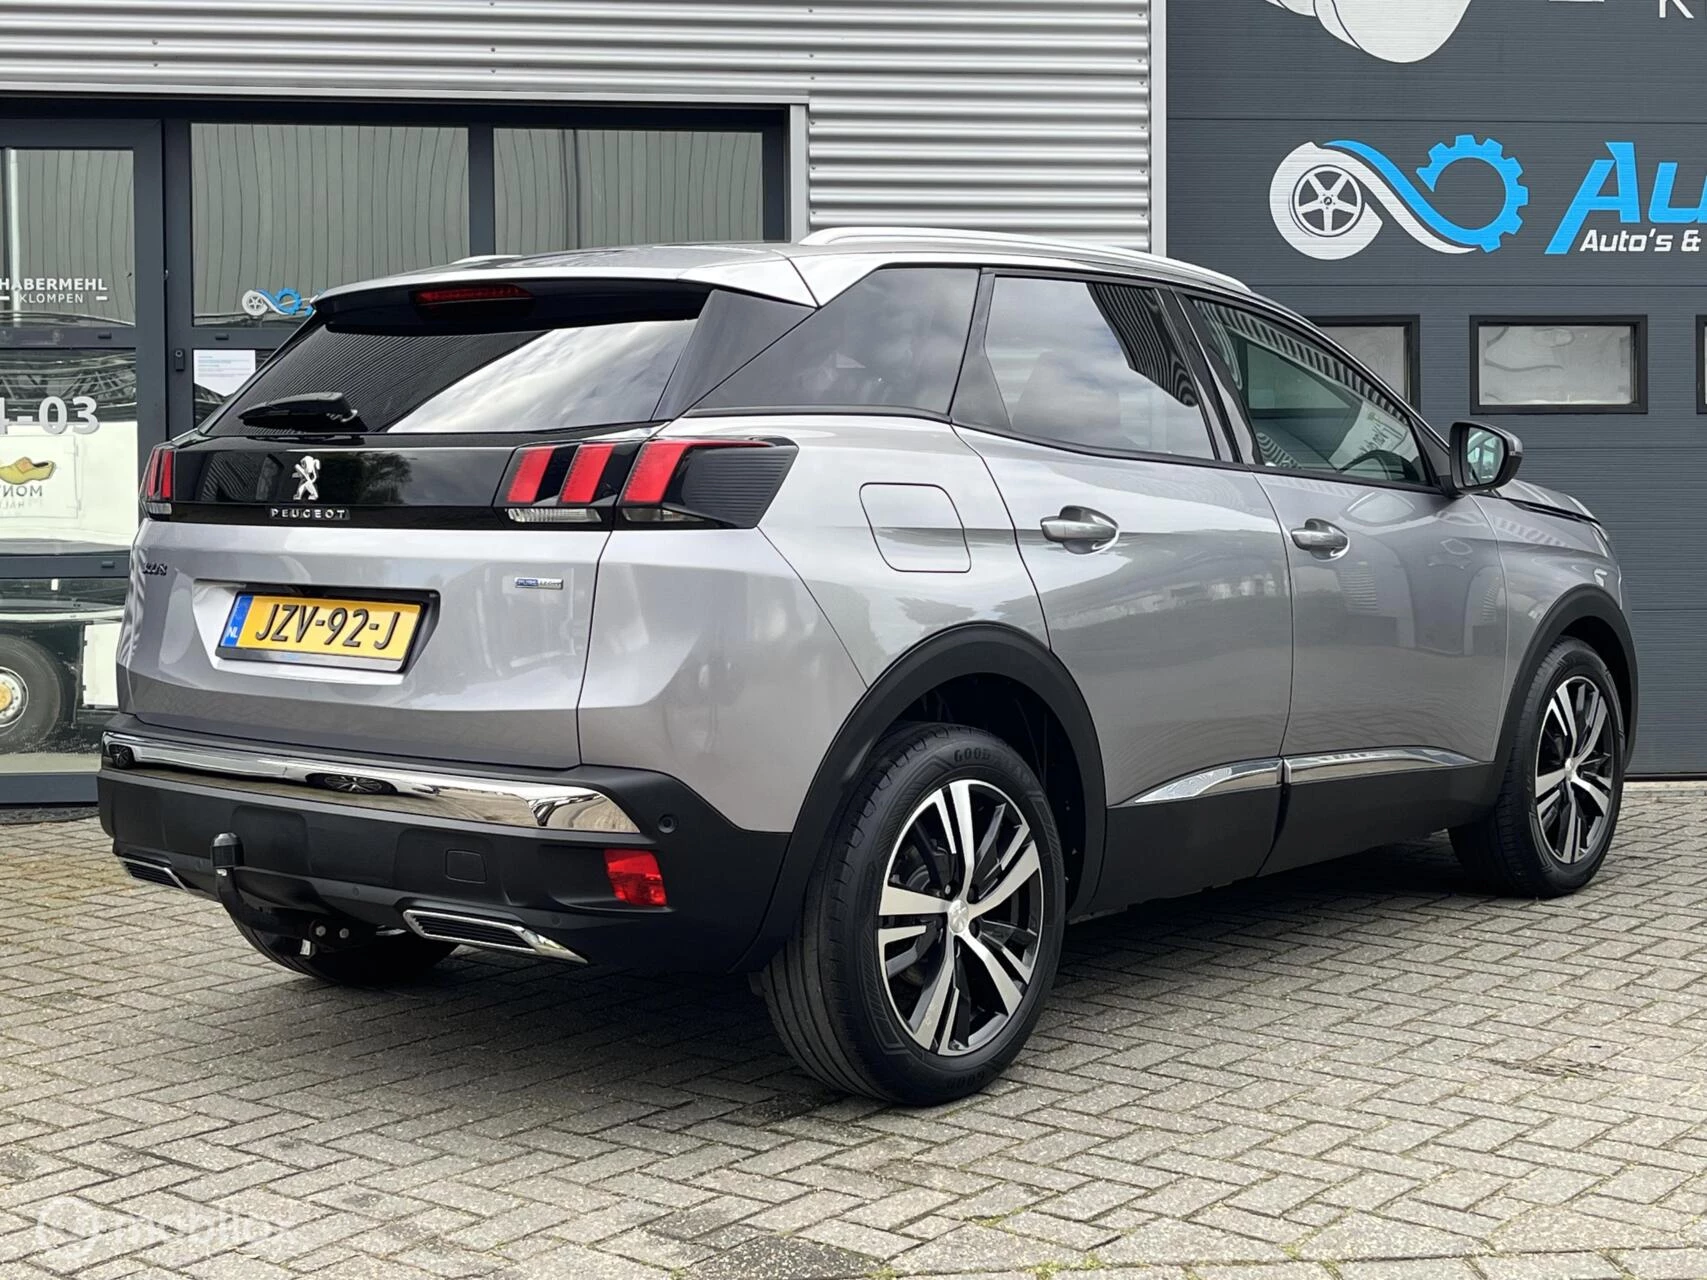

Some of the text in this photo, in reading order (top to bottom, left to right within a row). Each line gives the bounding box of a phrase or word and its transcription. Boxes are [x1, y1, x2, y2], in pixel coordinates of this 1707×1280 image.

[1579, 228, 1702, 252] Auto's &
[0, 278, 108, 291] HABERMEHL
[19, 293, 84, 304] KLOMPEN
[270, 508, 347, 519] PEUGEOT
[226, 626, 239, 639] NL
[255, 603, 401, 651] JZV-92-J
